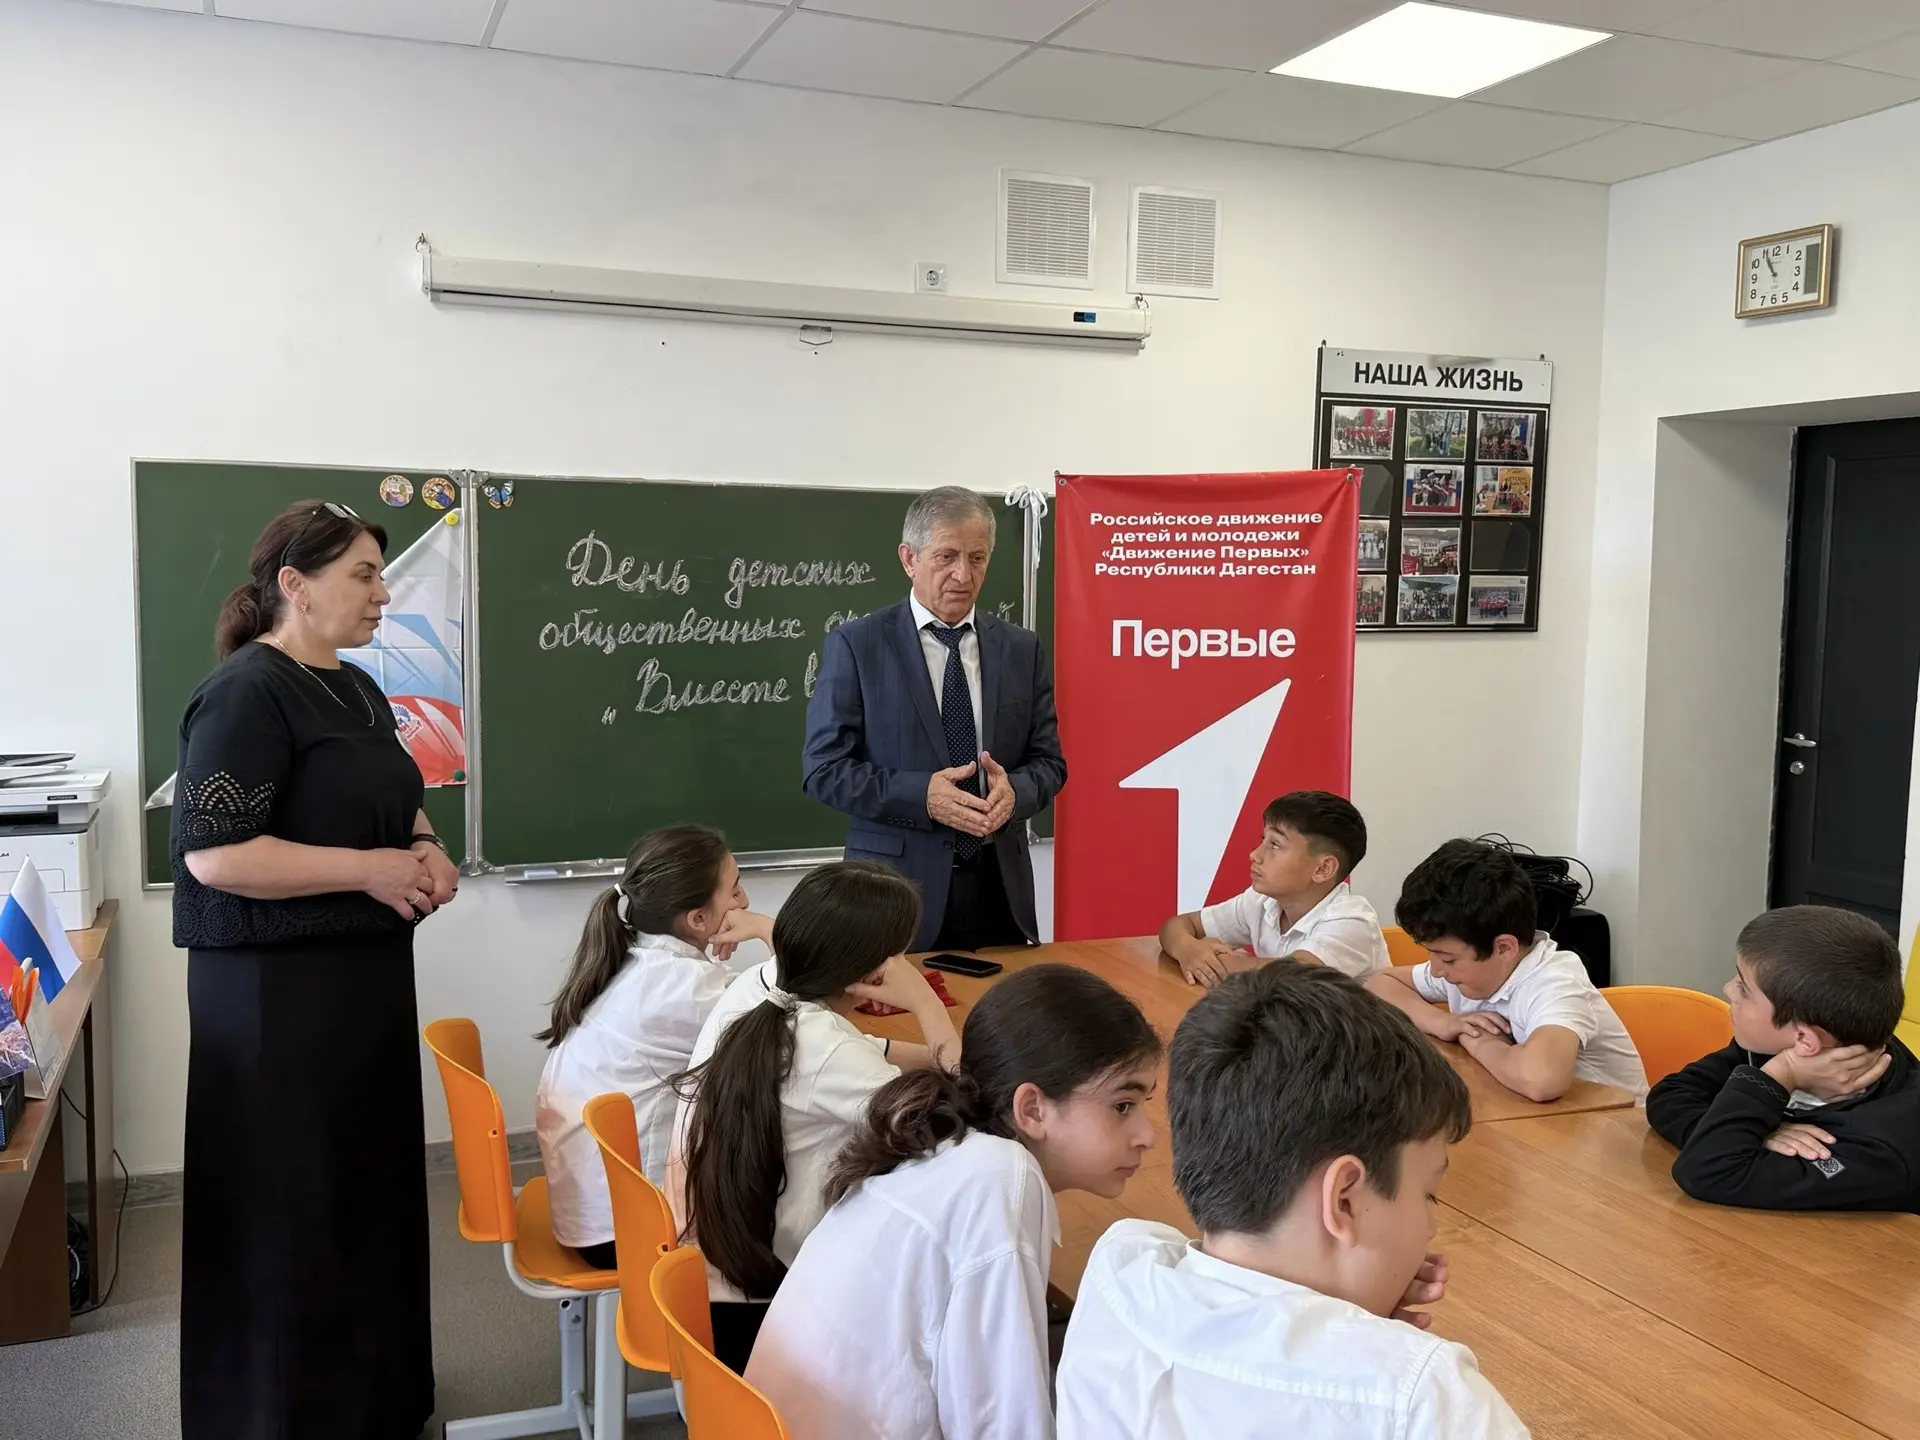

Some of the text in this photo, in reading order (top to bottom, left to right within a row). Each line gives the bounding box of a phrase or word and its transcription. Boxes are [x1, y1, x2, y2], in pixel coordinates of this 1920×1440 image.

[1772, 245, 1781, 257] 12
[1795, 250, 1802, 261] 2
[1751, 258, 1760, 269] 10
[1794, 266, 1801, 276] 3
[1751, 274, 1758, 284] 9
[1792, 281, 1799, 292] 4
[1750, 289, 1757, 299] 8
[1770, 294, 1777, 304] 6
[1781, 292, 1788, 303] 5
[1760, 295, 1766, 306] 7
[1354, 361, 1524, 392] НАША ЖИЗНЬ
[1090, 511, 1323, 526] Российское движение
[1111, 529, 1300, 544] детей и молодежи
[1102, 546, 1309, 561] «Движение Первых»
[565, 529, 876, 609] День детских
[1095, 562, 1316, 579] Республики Дагестан
[539, 607, 805, 655] общественных
[1112, 619, 1296, 670] Первые
